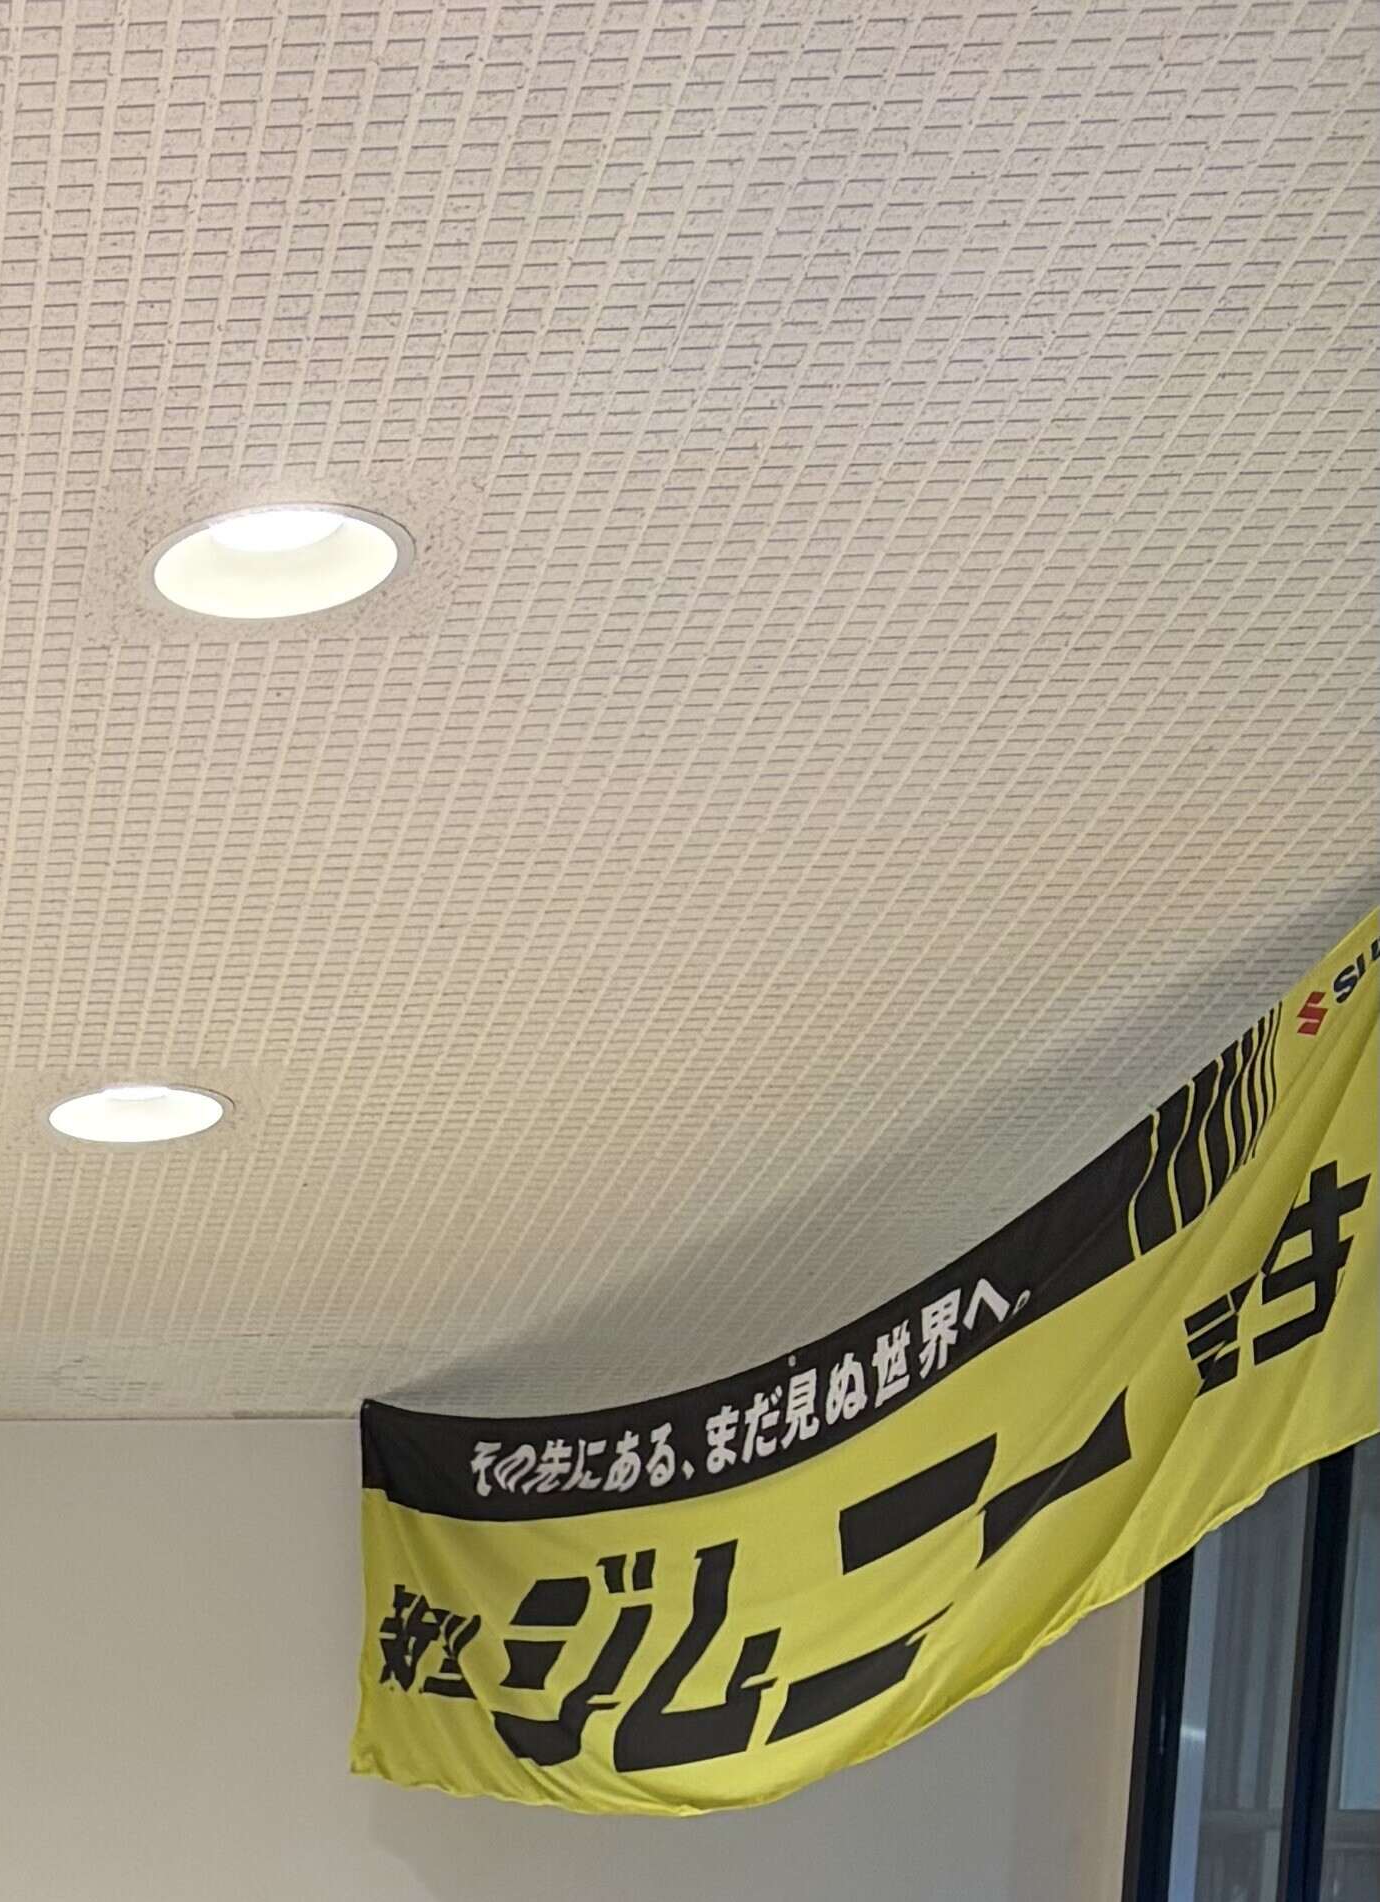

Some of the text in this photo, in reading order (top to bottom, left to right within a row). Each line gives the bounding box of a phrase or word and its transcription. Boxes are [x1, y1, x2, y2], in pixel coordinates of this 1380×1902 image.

[471, 1277, 1031, 1496] その先にある、まだ見ぬ世界へ。
